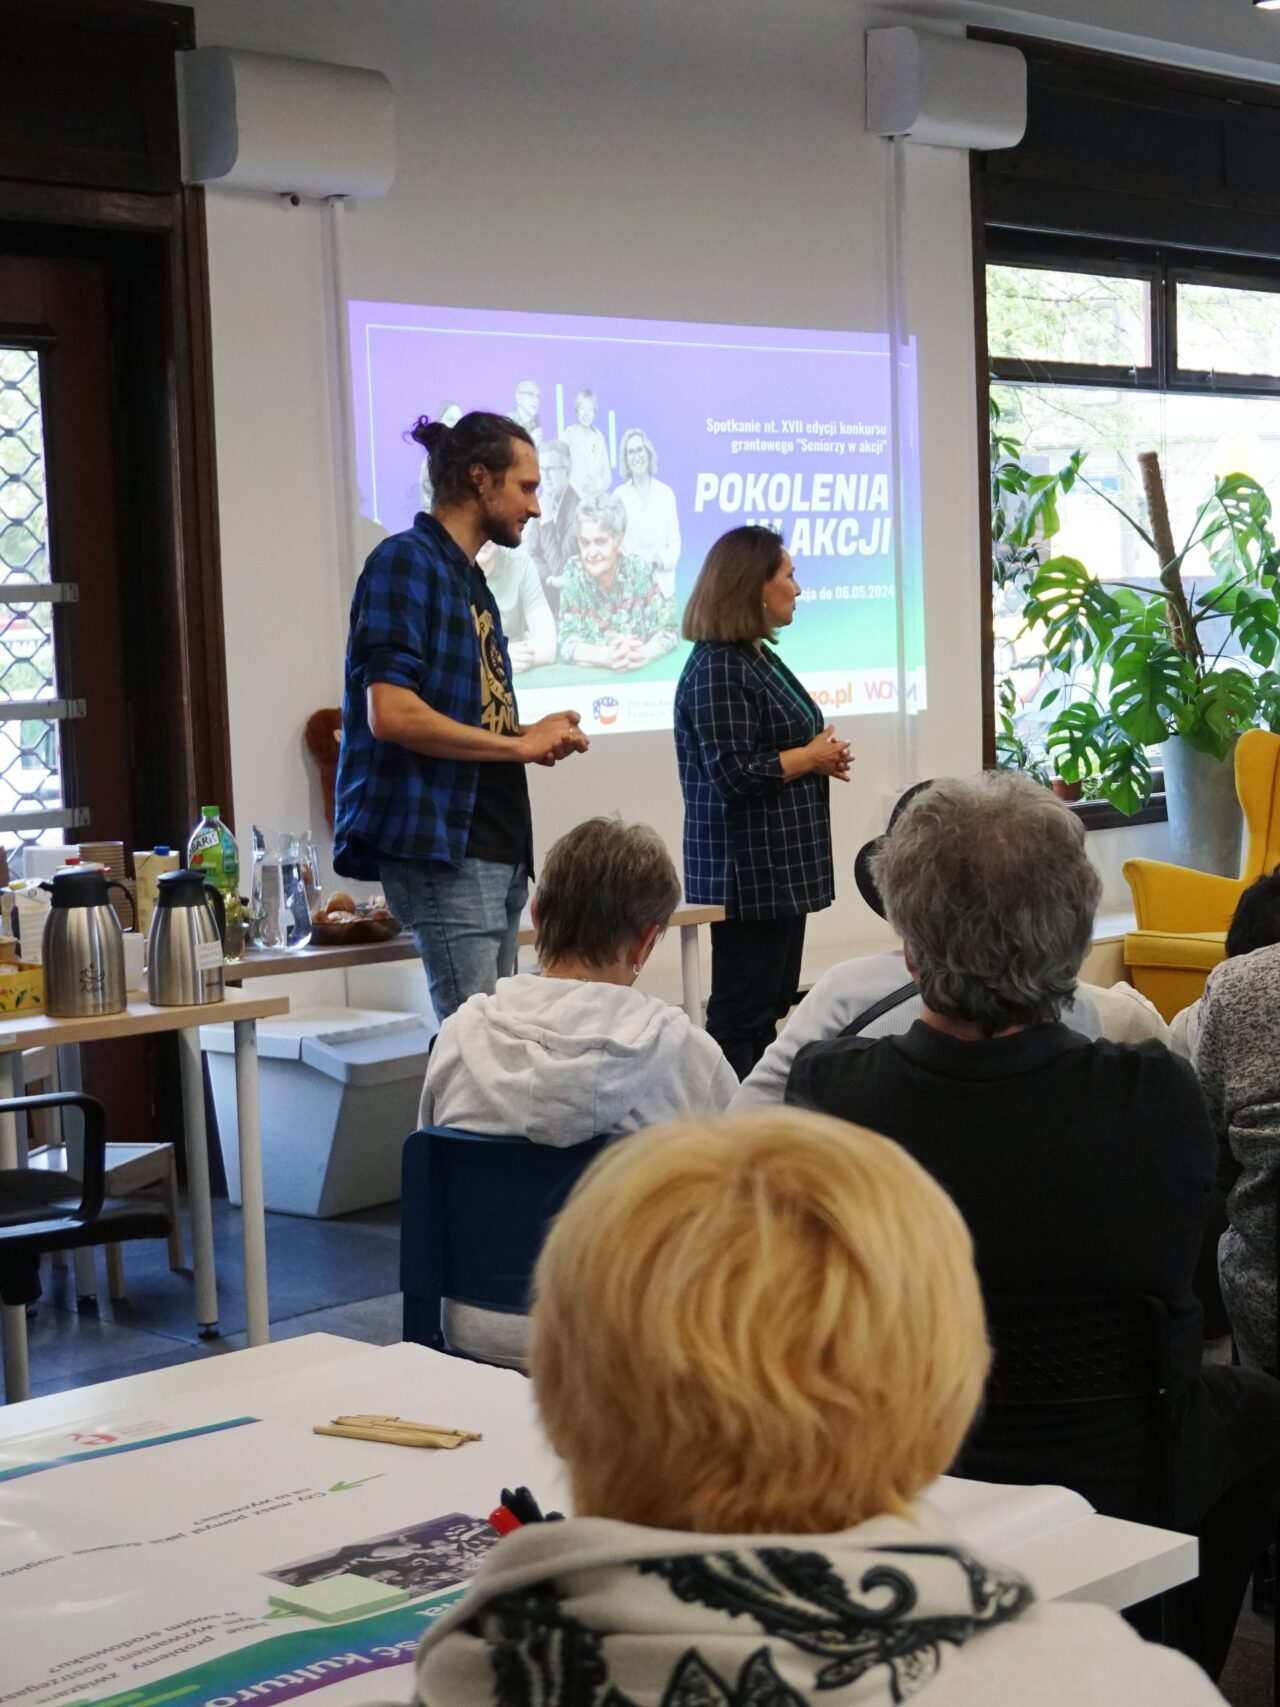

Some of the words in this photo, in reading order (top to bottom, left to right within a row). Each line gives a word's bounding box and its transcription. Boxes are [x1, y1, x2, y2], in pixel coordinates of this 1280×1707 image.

[706, 418, 761, 435] Spotkanie
[764, 420, 778, 433] nt.
[781, 420, 803, 433] XVII
[806, 421, 837, 436] edycji
[840, 422, 887, 436] konkursu
[731, 439, 794, 455] grantowego
[797, 438, 845, 455] "Seniorzy
[848, 443, 857, 452] w
[859, 440, 887, 455] akcji"
[694, 473, 890, 513] POKOLENIA
[789, 517, 892, 557] AKCJI
[820, 587, 833, 601] do
[835, 585, 895, 601] 06.05.2024
[115, 1624, 218, 1662] wyzwaniem
[132, 1635, 215, 1671] problemy
